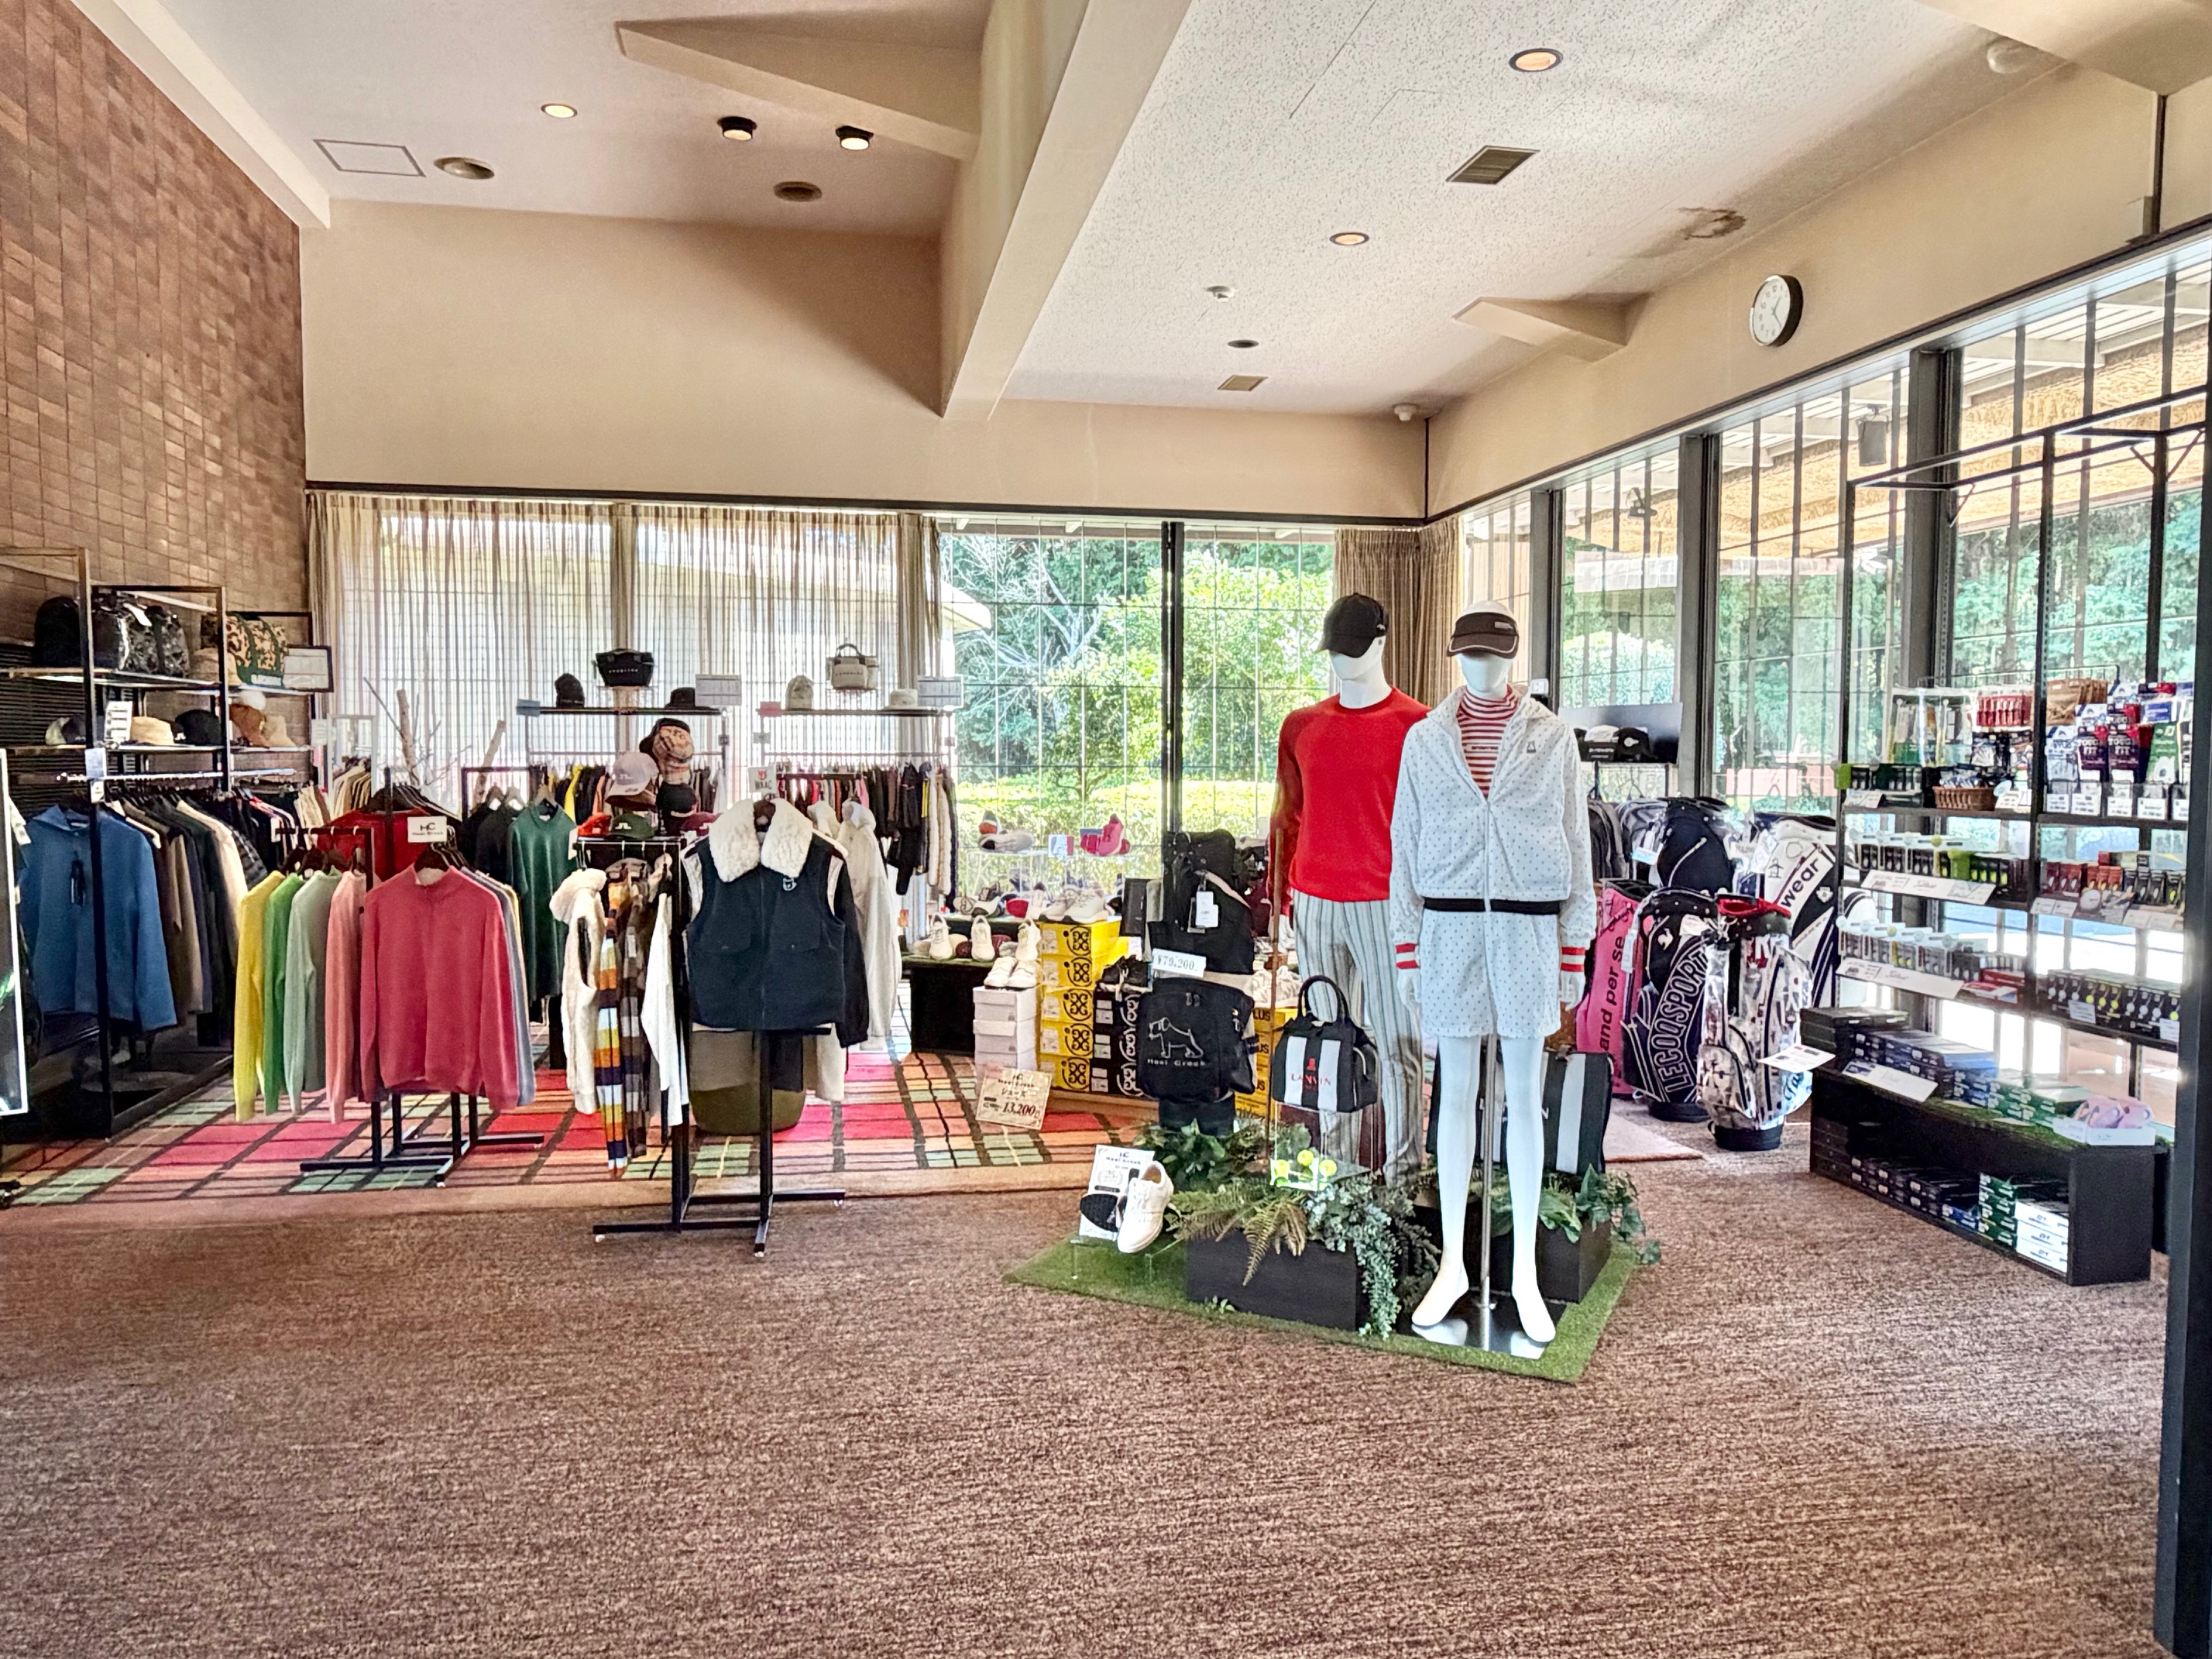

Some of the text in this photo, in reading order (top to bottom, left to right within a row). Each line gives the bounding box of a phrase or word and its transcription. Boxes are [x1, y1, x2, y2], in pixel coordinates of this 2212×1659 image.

[1252, 1008, 1271, 1022] LUS
[1599, 936, 1625, 1051] and per se
